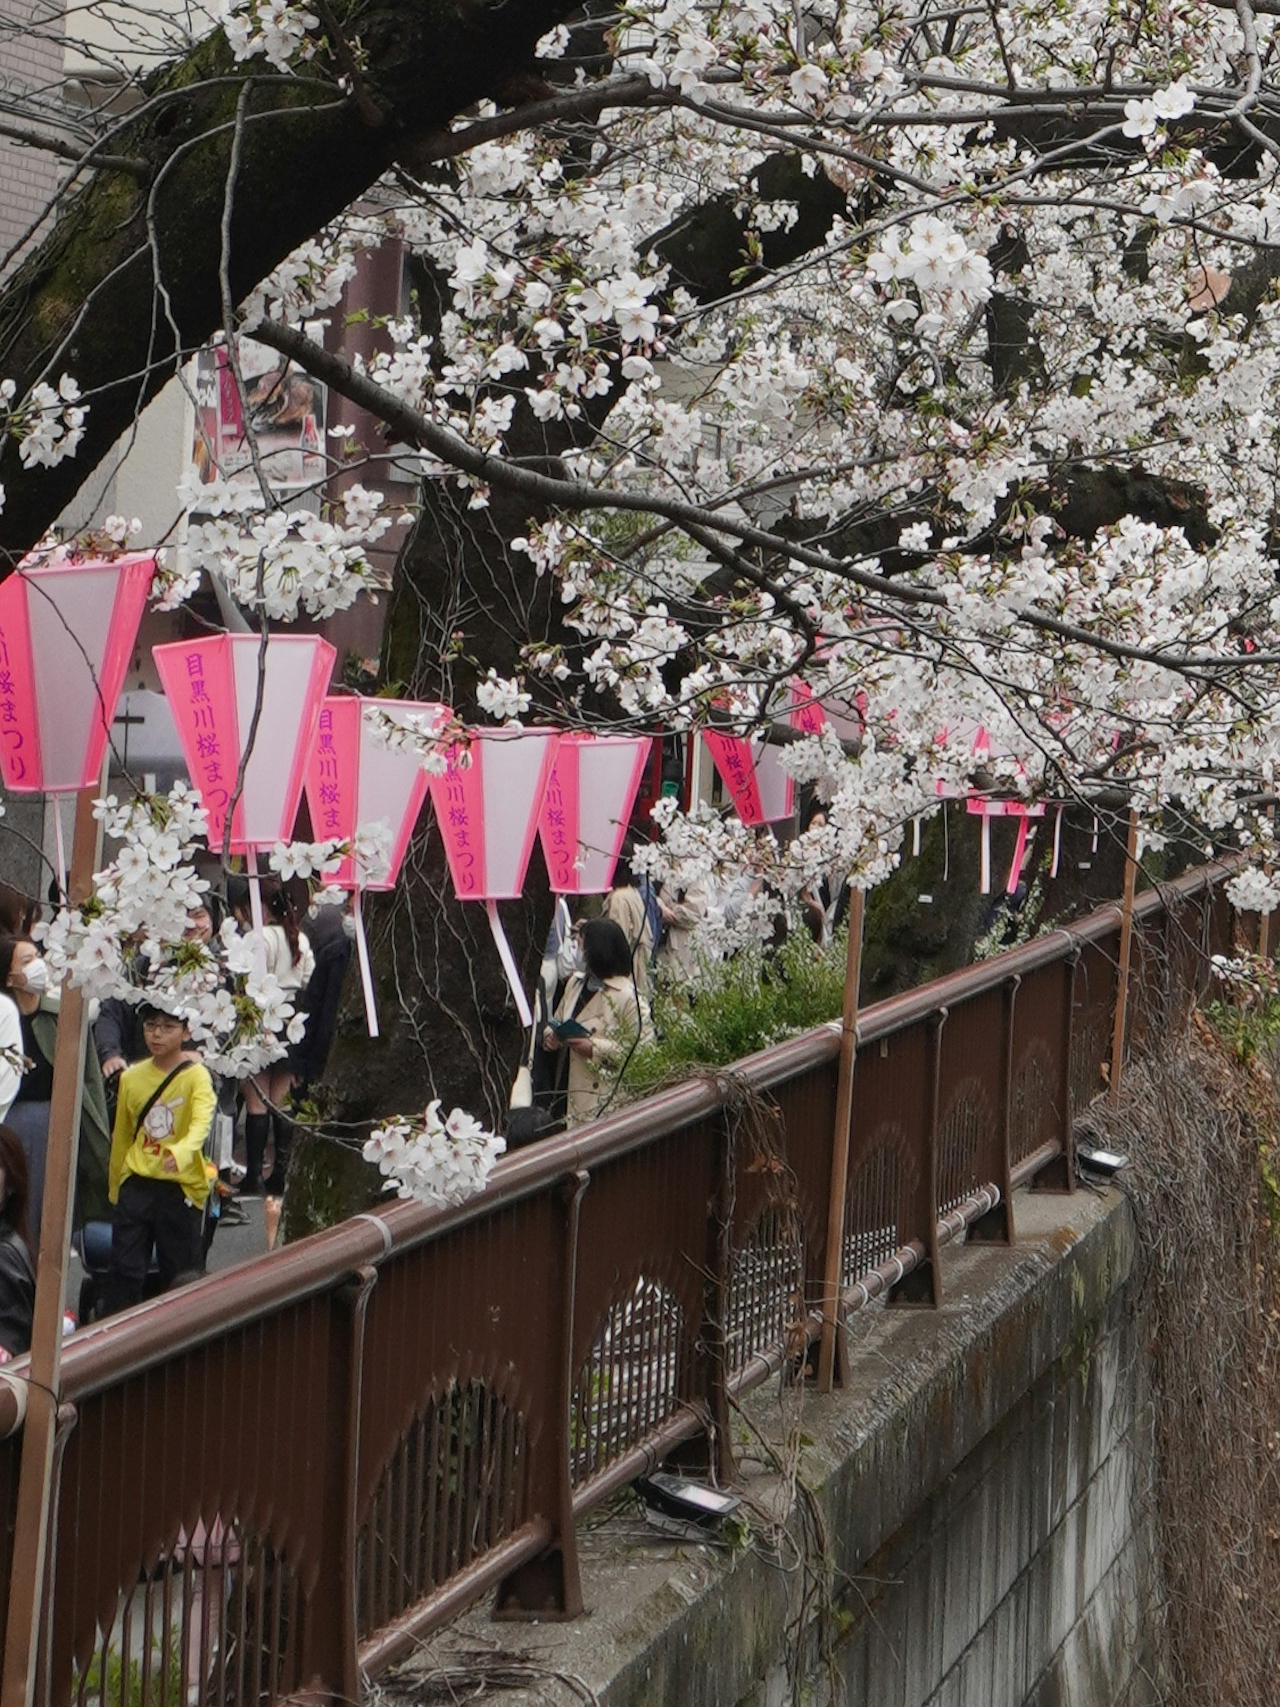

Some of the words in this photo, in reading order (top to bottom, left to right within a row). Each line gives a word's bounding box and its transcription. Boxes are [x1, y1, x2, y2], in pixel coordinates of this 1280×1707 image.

[0, 629, 25, 781] 桜まつり
[714, 734, 756, 820] 川桜まつり
[318, 709, 342, 876] 目黒川桜ま
